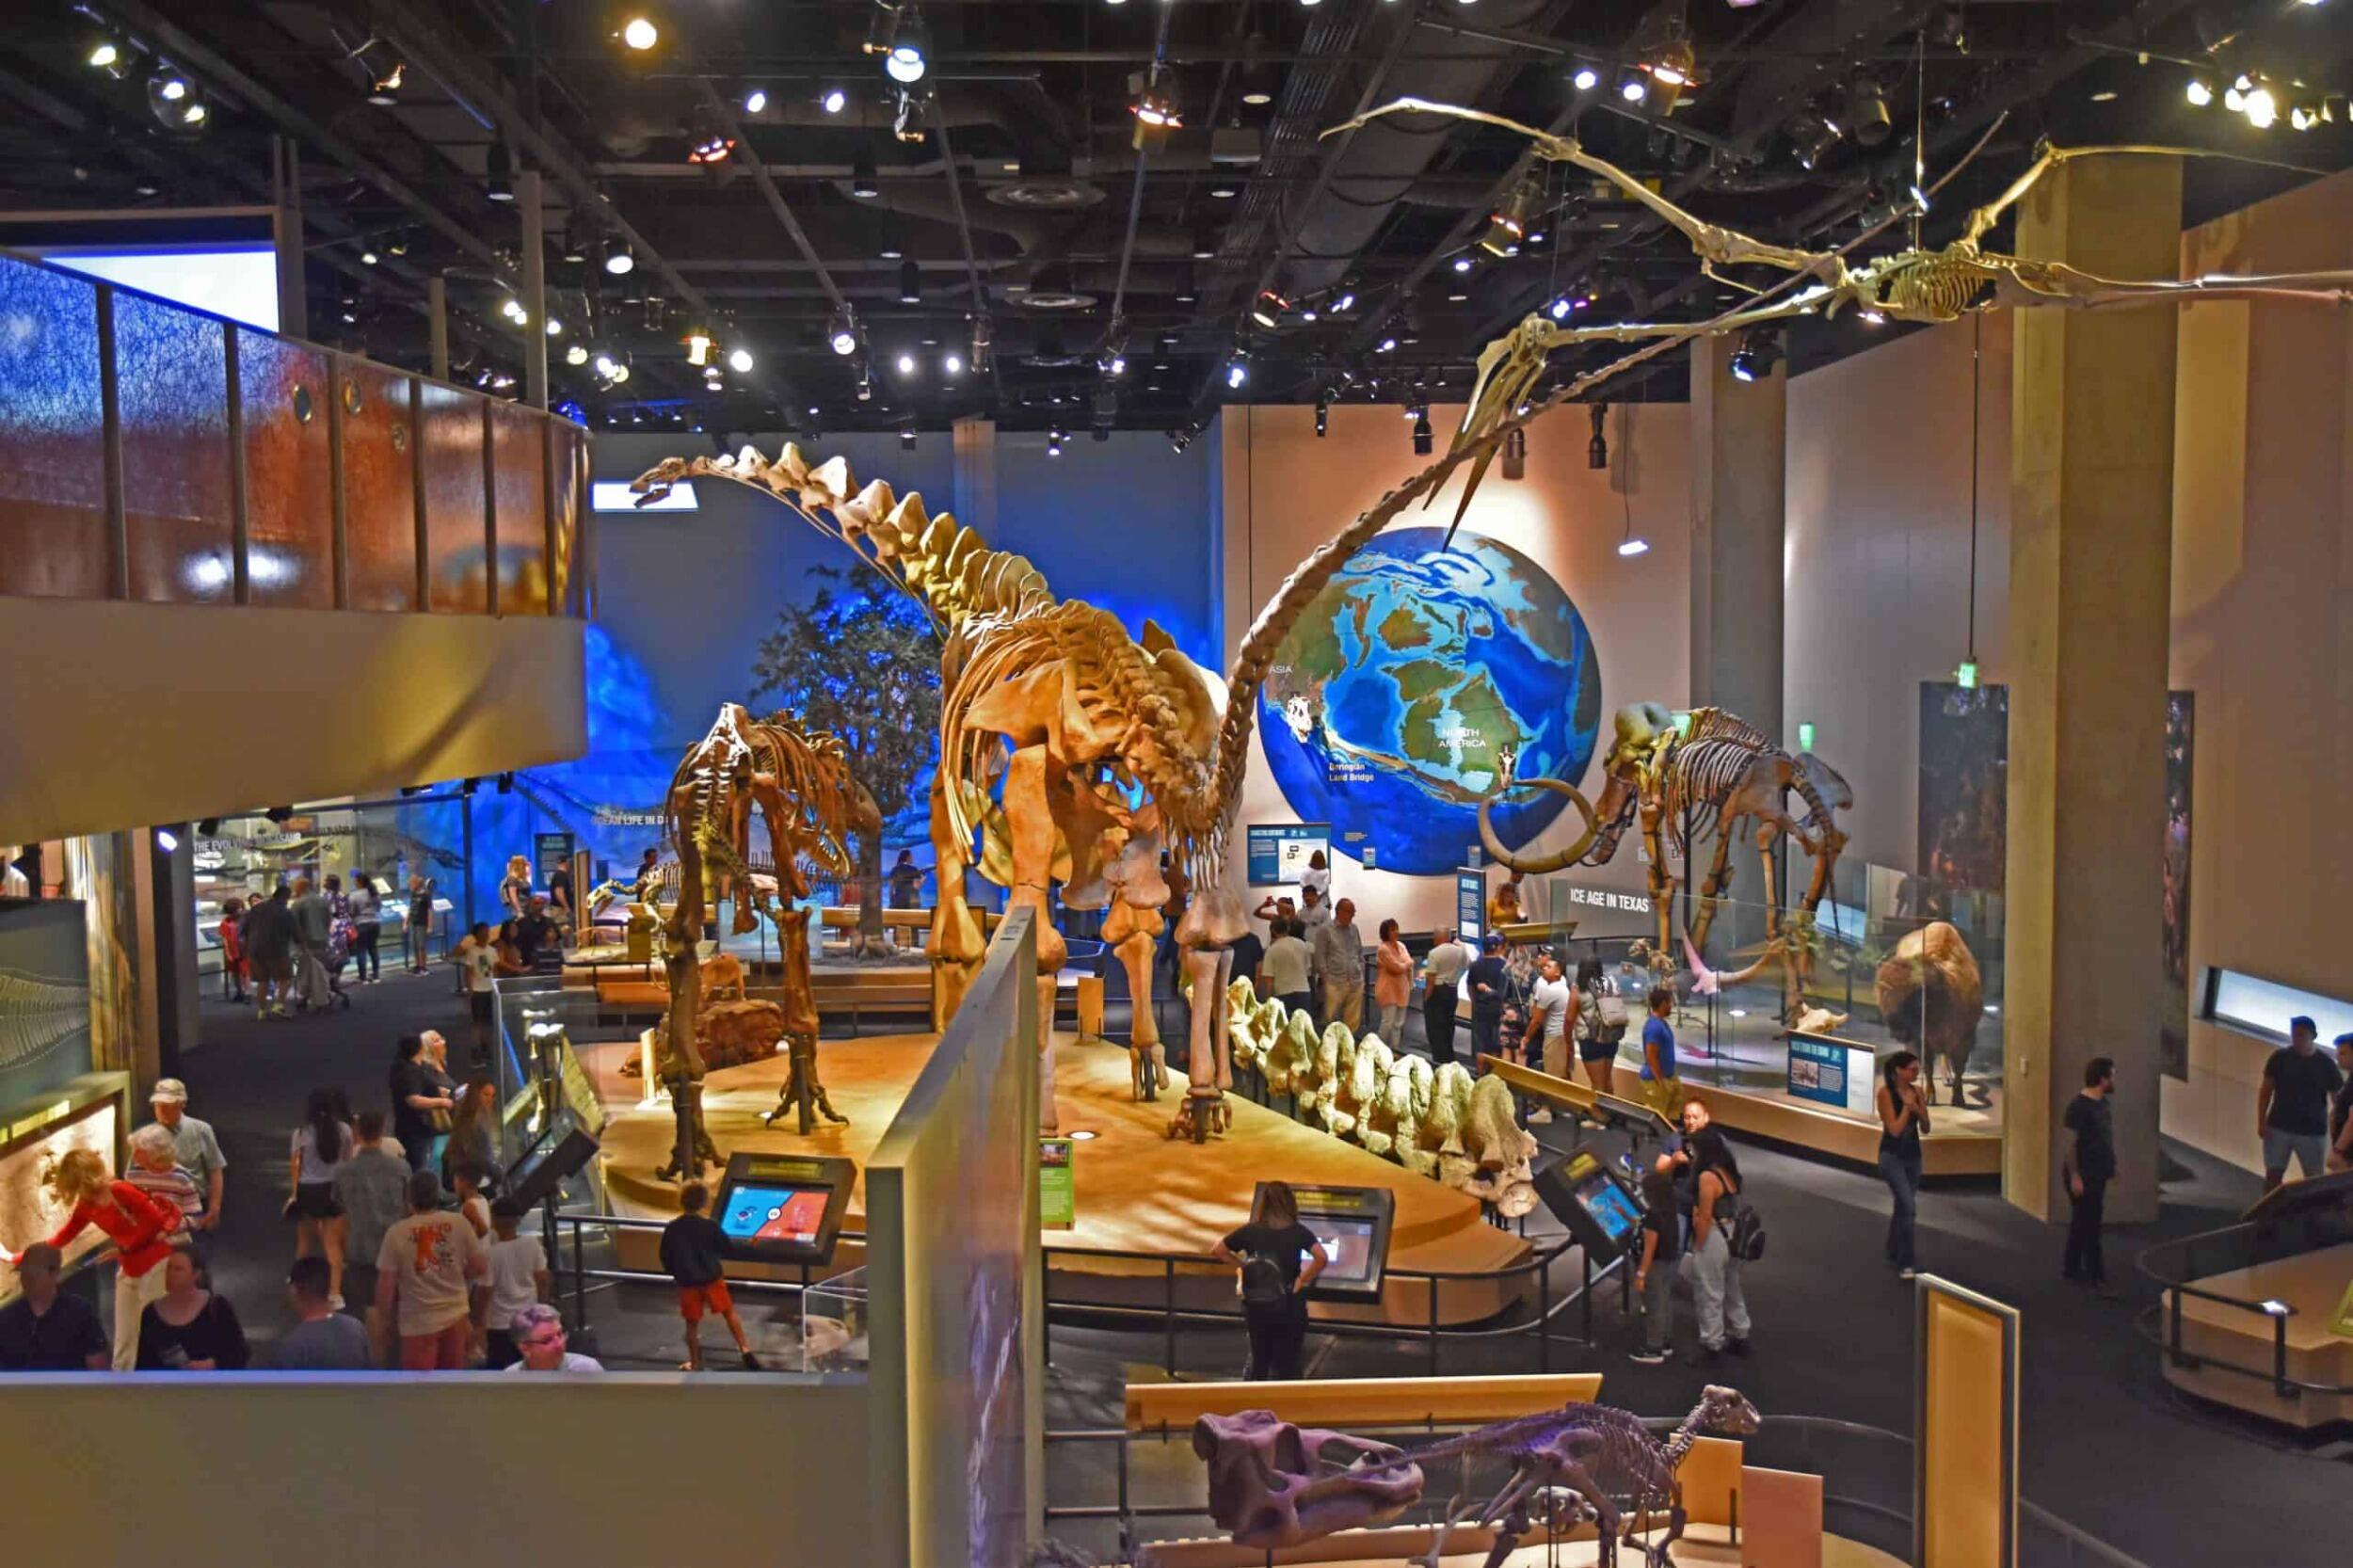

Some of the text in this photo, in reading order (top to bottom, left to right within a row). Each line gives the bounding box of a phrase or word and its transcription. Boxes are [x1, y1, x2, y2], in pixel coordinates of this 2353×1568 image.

[1438, 739, 1486, 748] AMERICA
[1329, 773, 1374, 782] Land Bridge
[194, 841, 210, 852] THE
[1570, 888, 1650, 913] ICE AGE IN TEXAS
